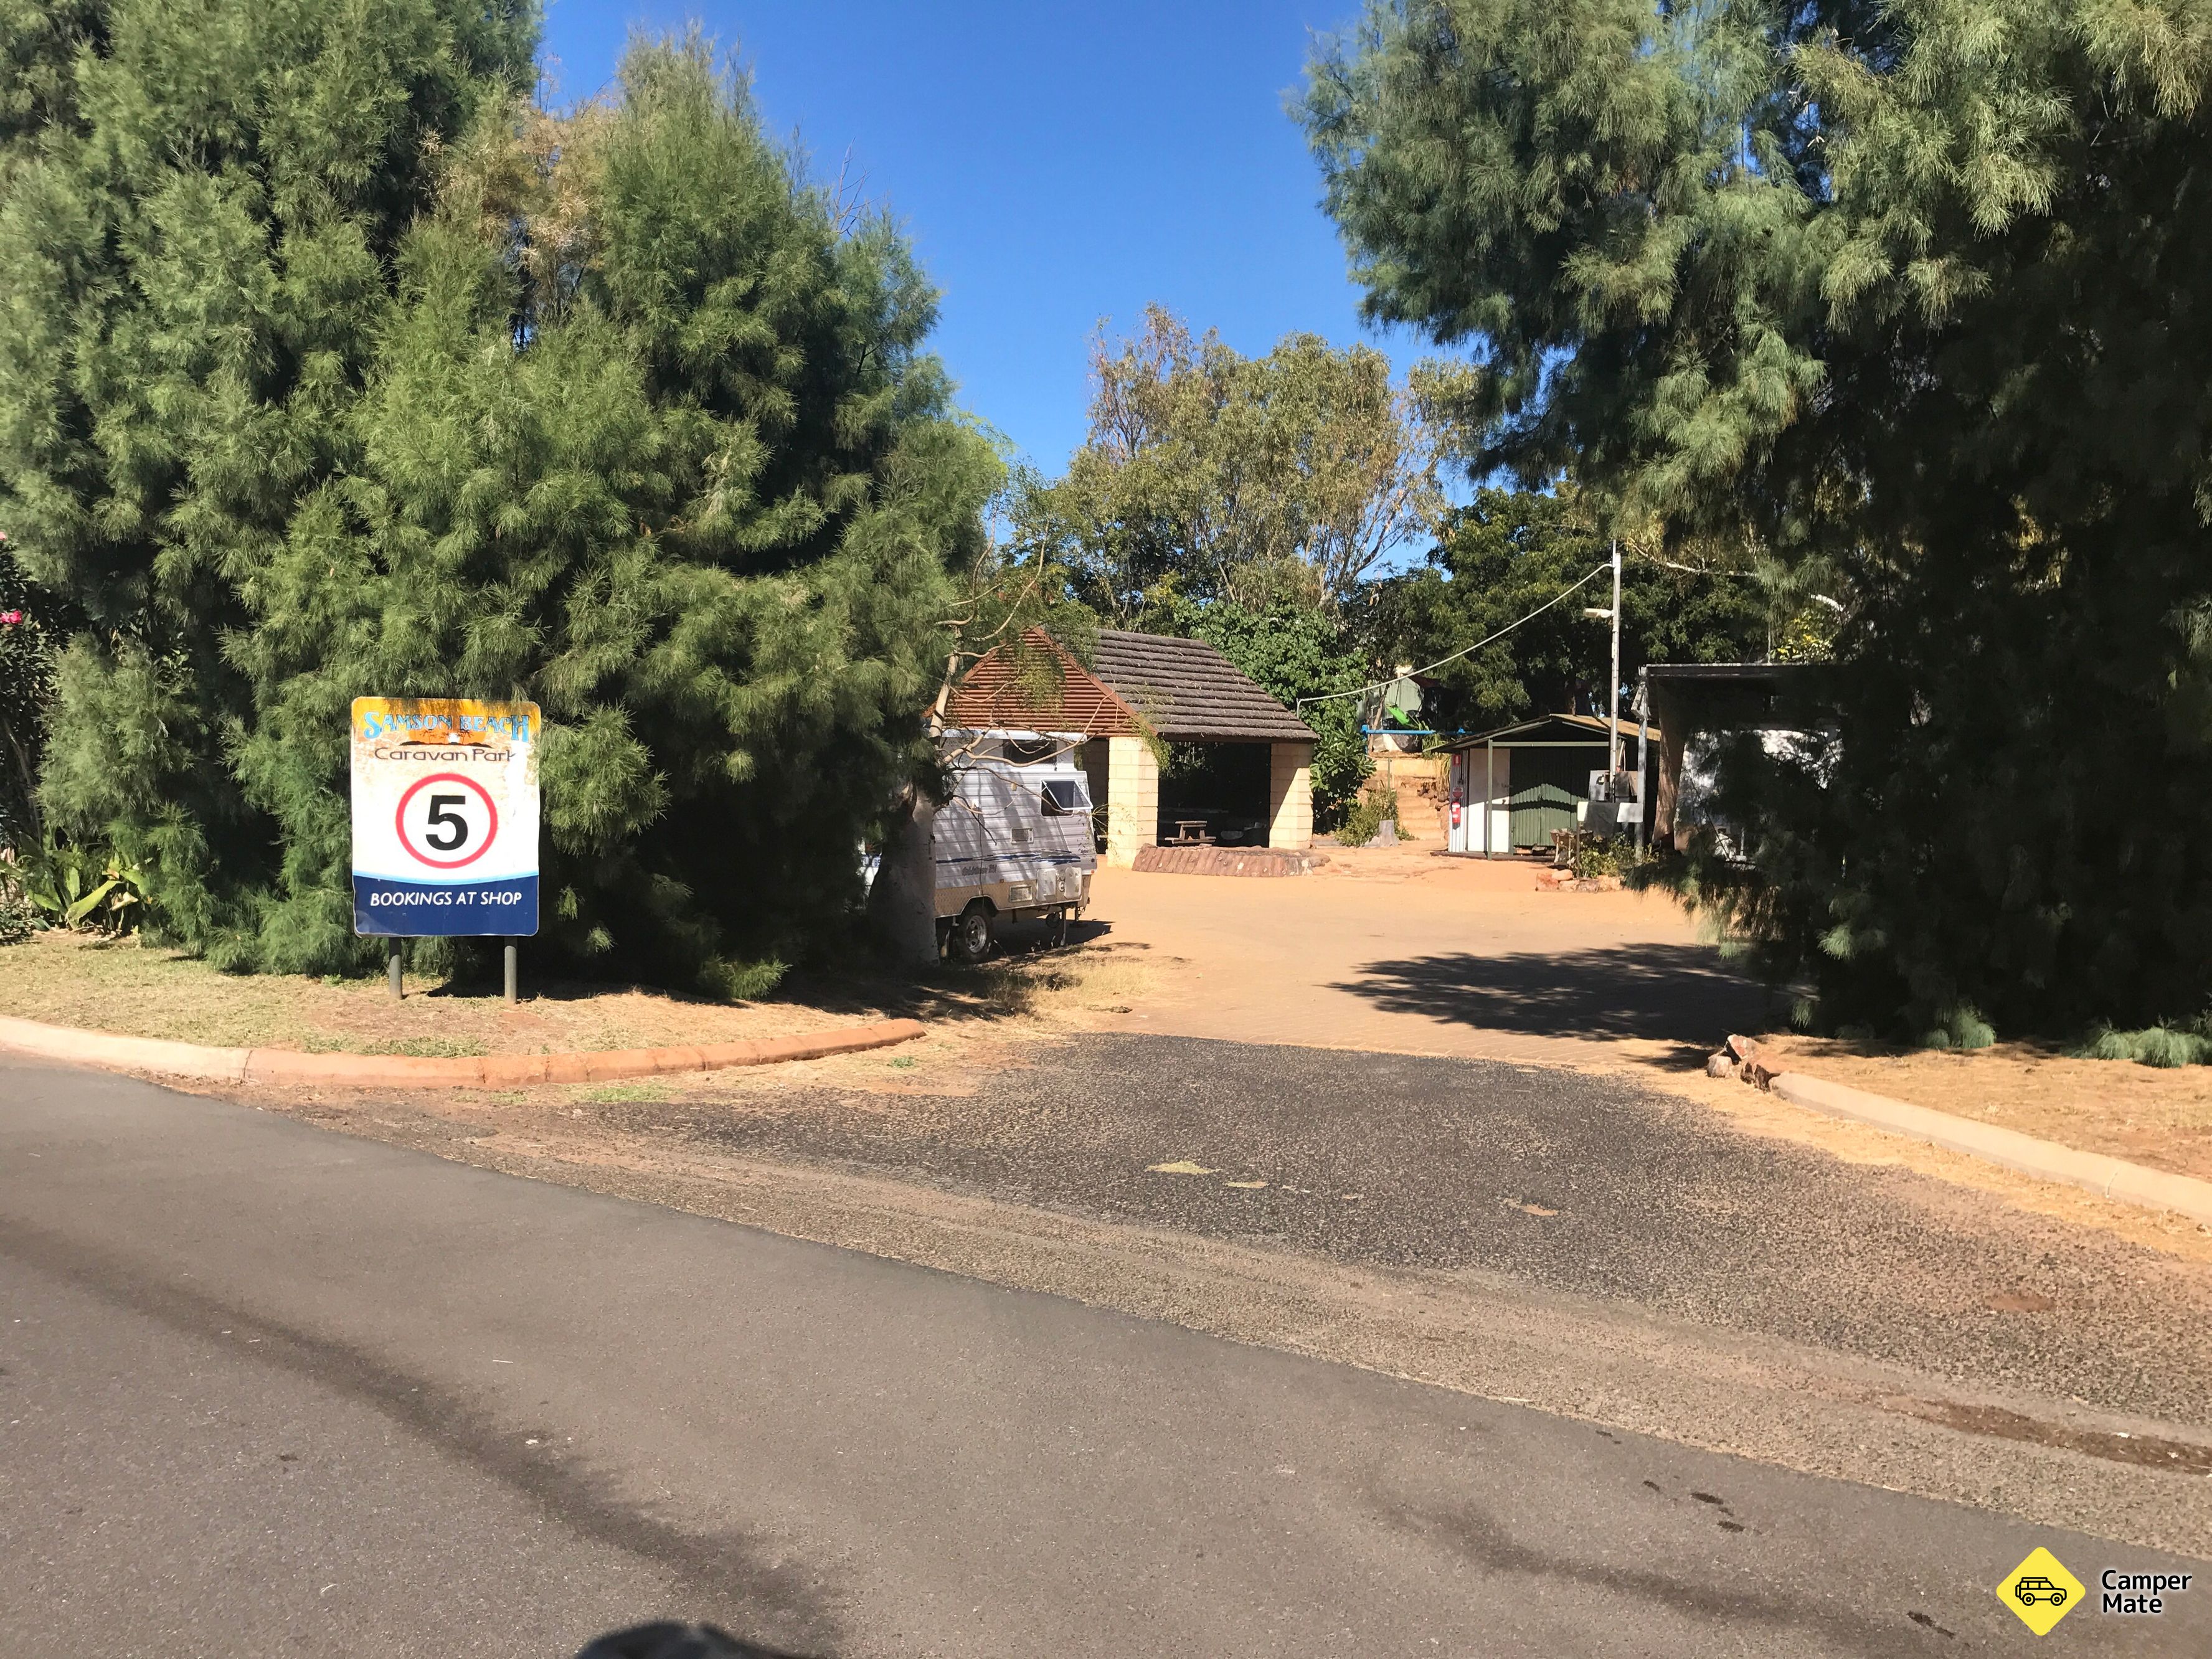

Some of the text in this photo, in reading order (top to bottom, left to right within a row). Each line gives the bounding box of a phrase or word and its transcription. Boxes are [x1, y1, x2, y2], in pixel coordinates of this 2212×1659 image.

[364, 711, 529, 742] SAMSON BEACH
[374, 747, 468, 761] Caravan
[425, 795, 468, 851] 5
[370, 891, 522, 907] BOOKINGS AT SHOP
